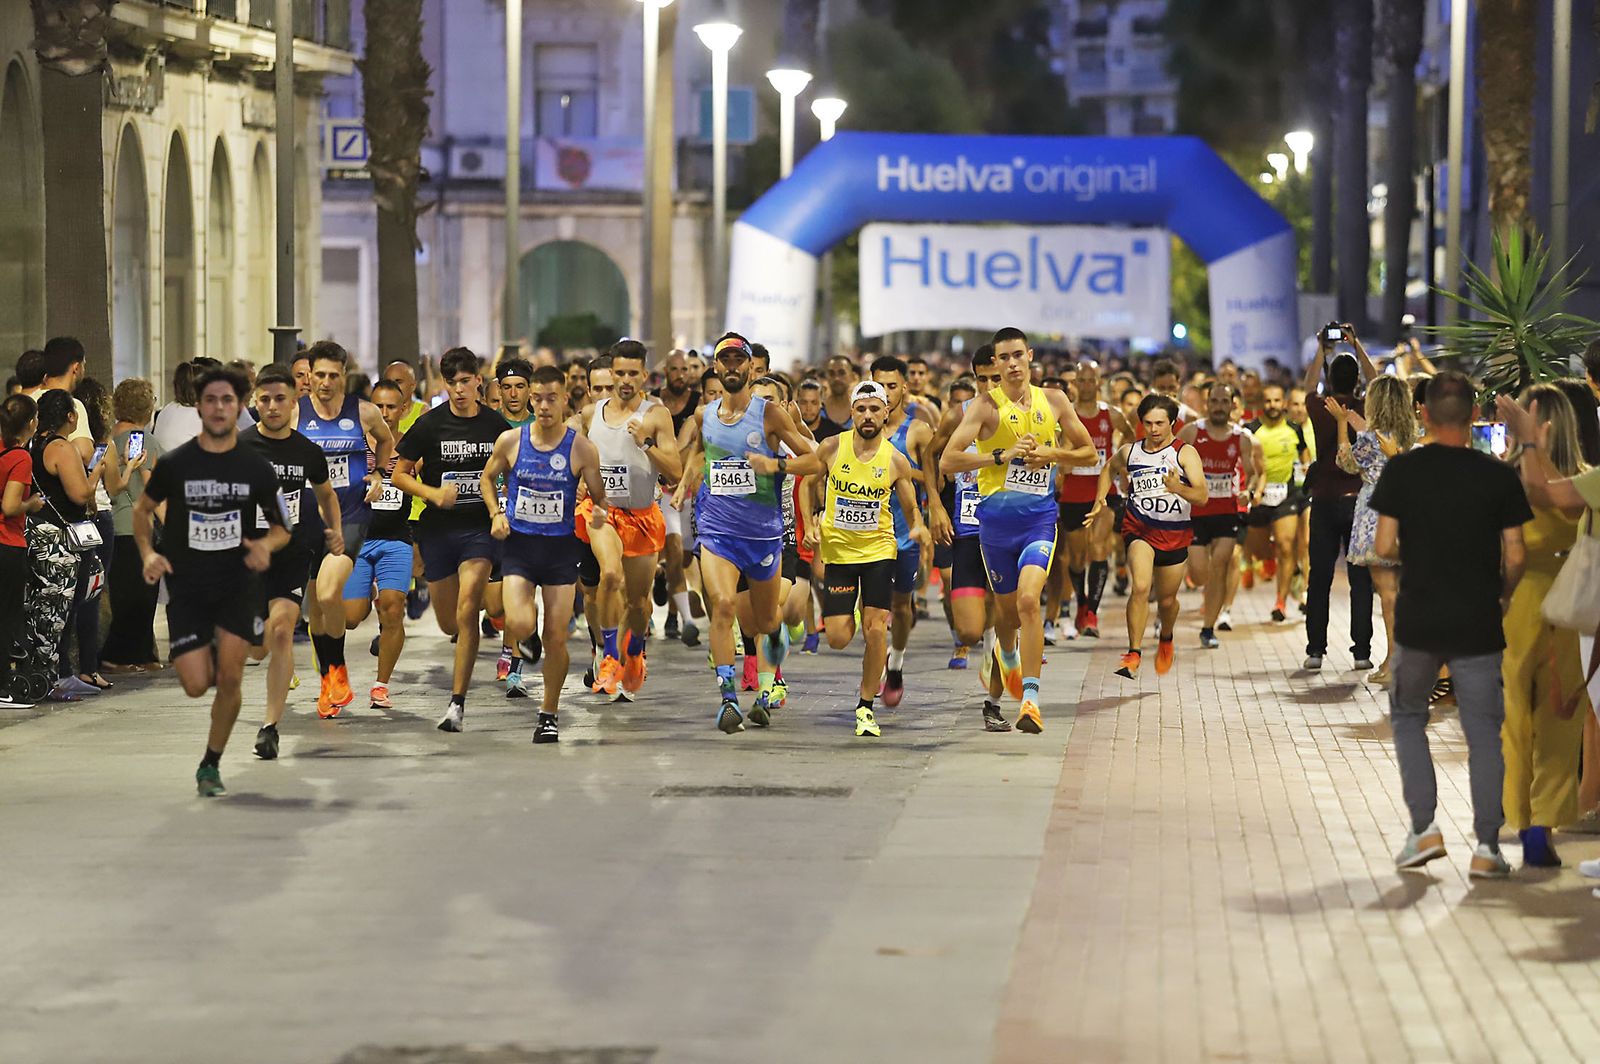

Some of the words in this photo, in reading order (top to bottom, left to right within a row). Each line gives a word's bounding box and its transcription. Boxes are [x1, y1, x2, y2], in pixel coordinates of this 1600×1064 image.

[876, 154, 1013, 192] Huelva
[1024, 157, 1157, 202] original
[880, 235, 1125, 294] Huelva
[442, 443, 460, 454] RUN
[461, 443, 477, 453] FOR
[287, 465, 304, 476] FUN
[1018, 470, 1040, 484] 249
[720, 473, 741, 485] 646
[1141, 477, 1158, 490] 303
[187, 483, 208, 496] RUN
[209, 482, 230, 496] FOR
[834, 479, 886, 498] JUCAMP
[532, 503, 546, 514] 13
[1141, 497, 1182, 513] ODA
[845, 510, 867, 522] 655
[203, 526, 227, 540] 198
